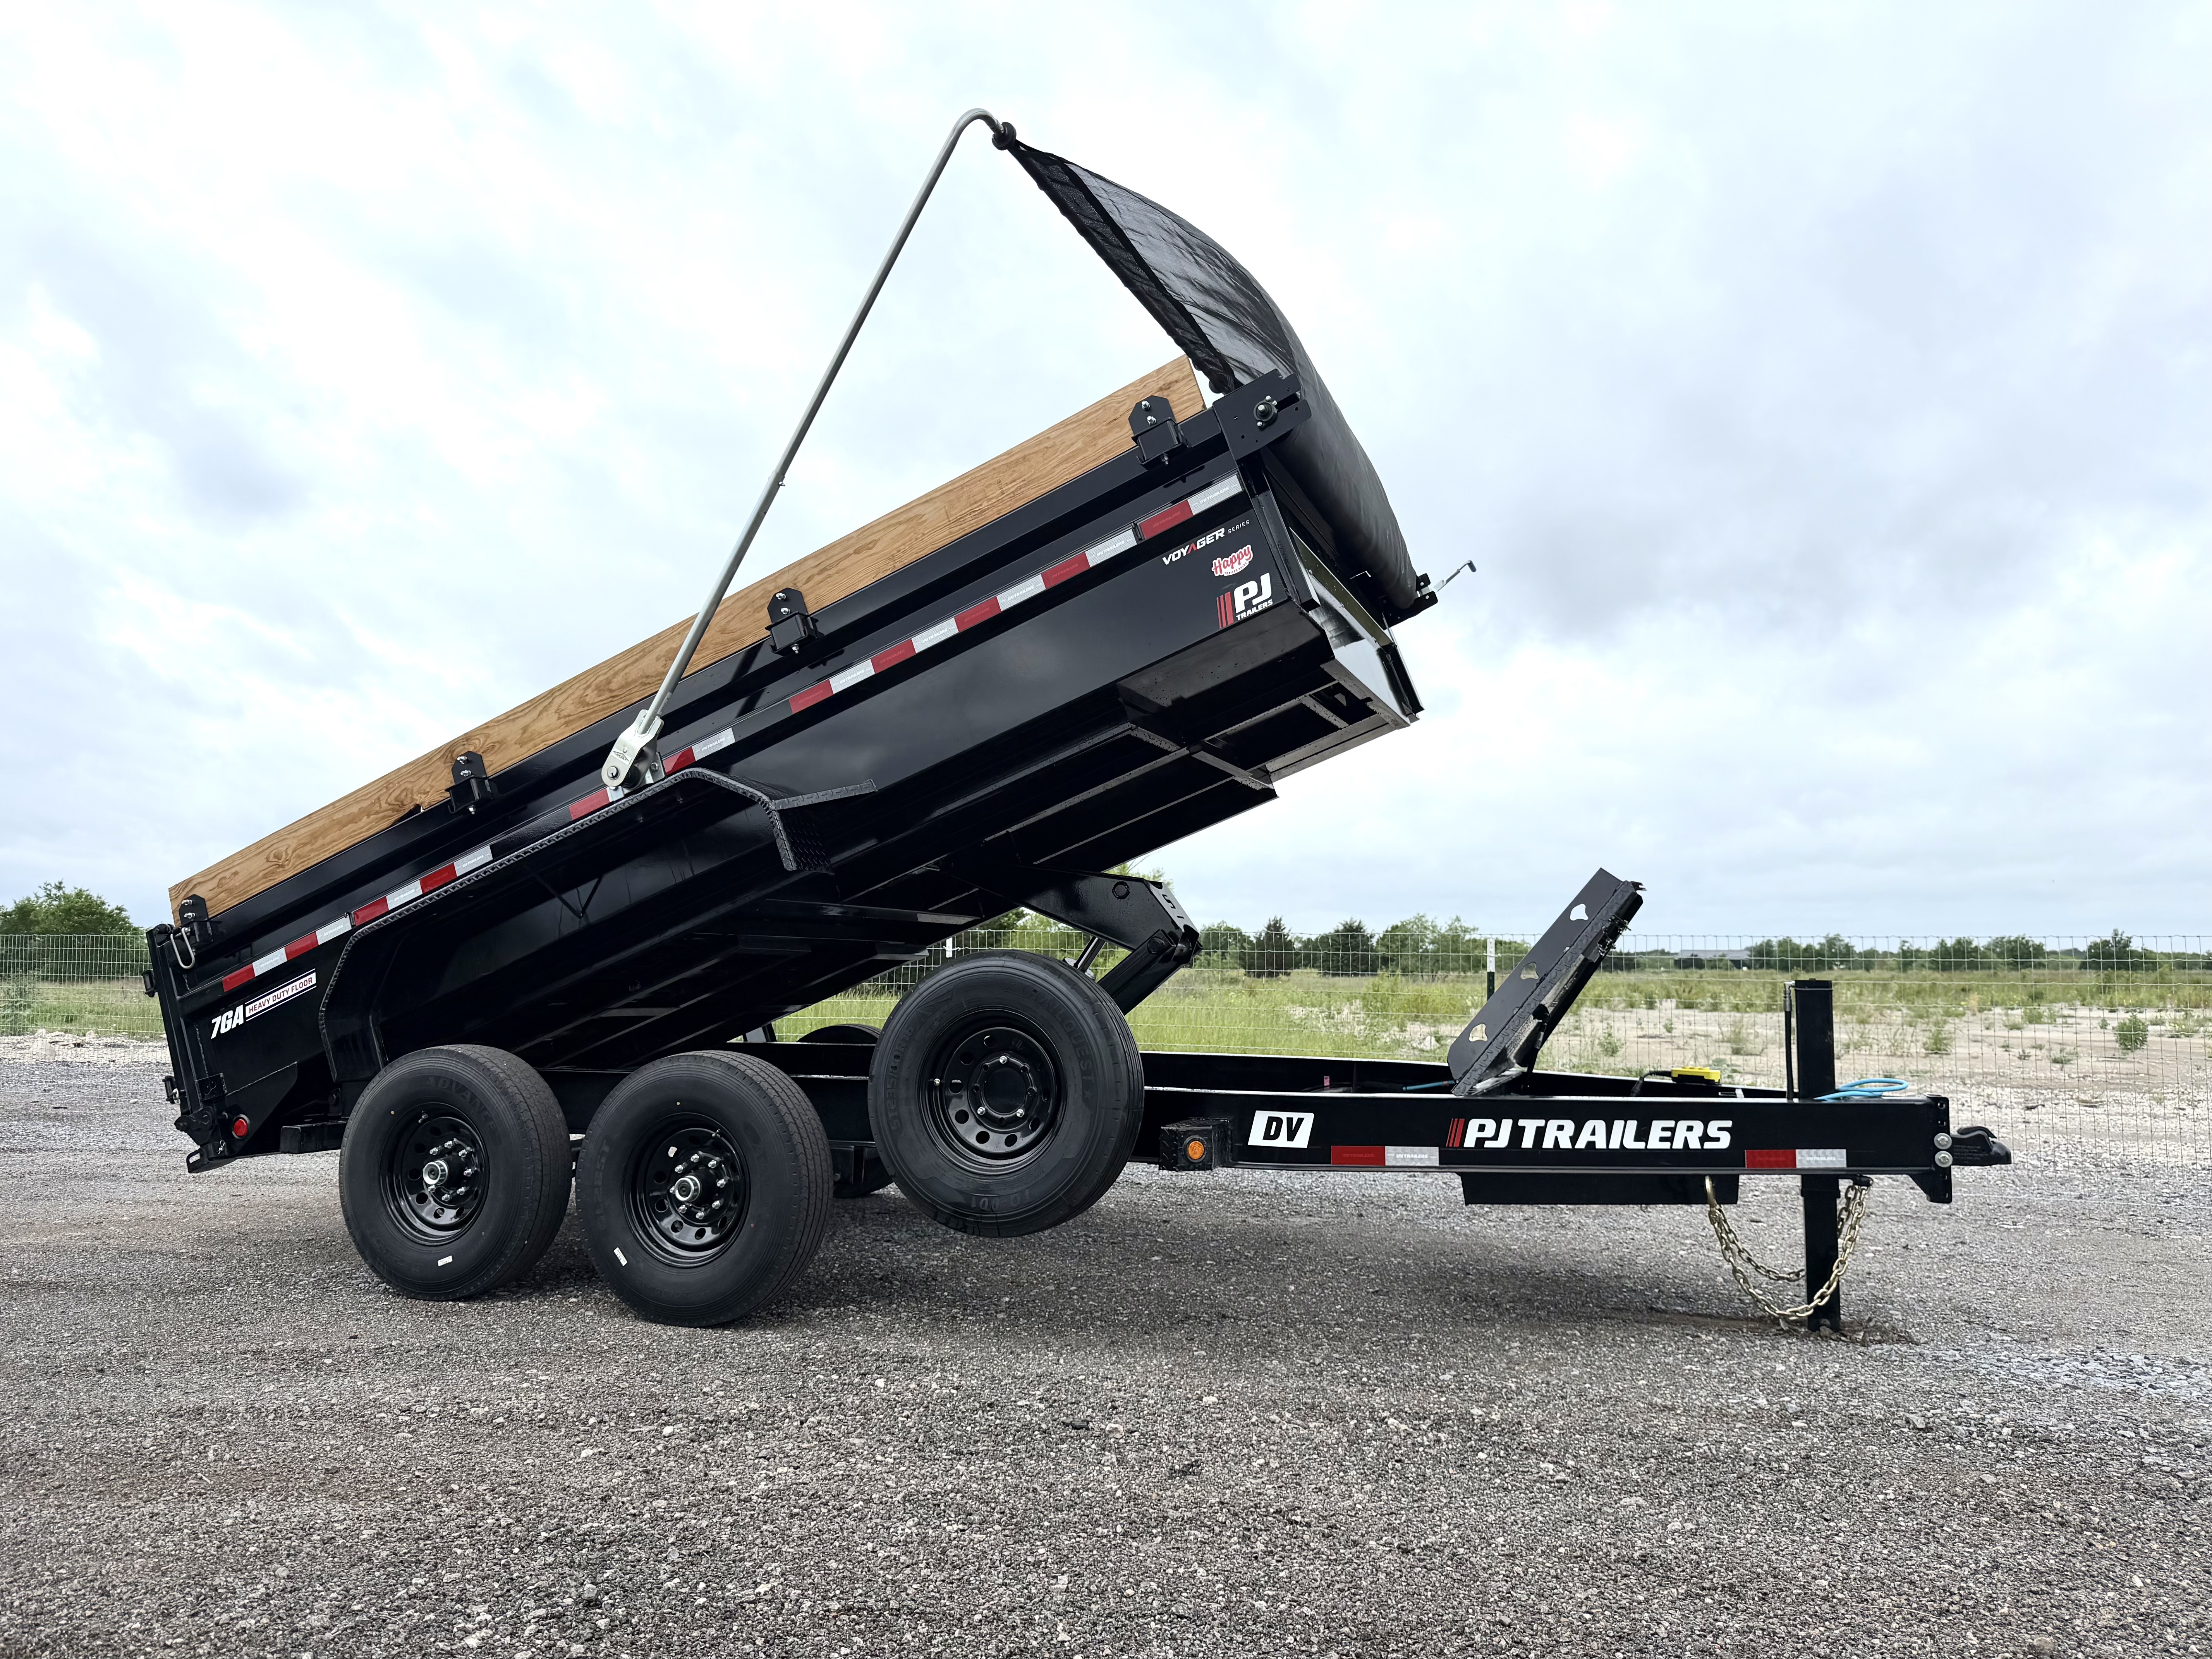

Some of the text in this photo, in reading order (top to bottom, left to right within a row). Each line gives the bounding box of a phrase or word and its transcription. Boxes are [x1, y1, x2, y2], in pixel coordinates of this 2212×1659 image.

[1163, 520, 1250, 565] VOYAGER SERIES
[1213, 546, 1252, 575] Happy
[1234, 573, 1272, 613] PJ
[1236, 599, 1273, 621] TRAILERS
[211, 977, 313, 1039] 7GA HEAVY DUTY FLOOR
[1262, 1116, 1304, 1142] DV
[1463, 1118, 1733, 1149] PJ TRAILERS
